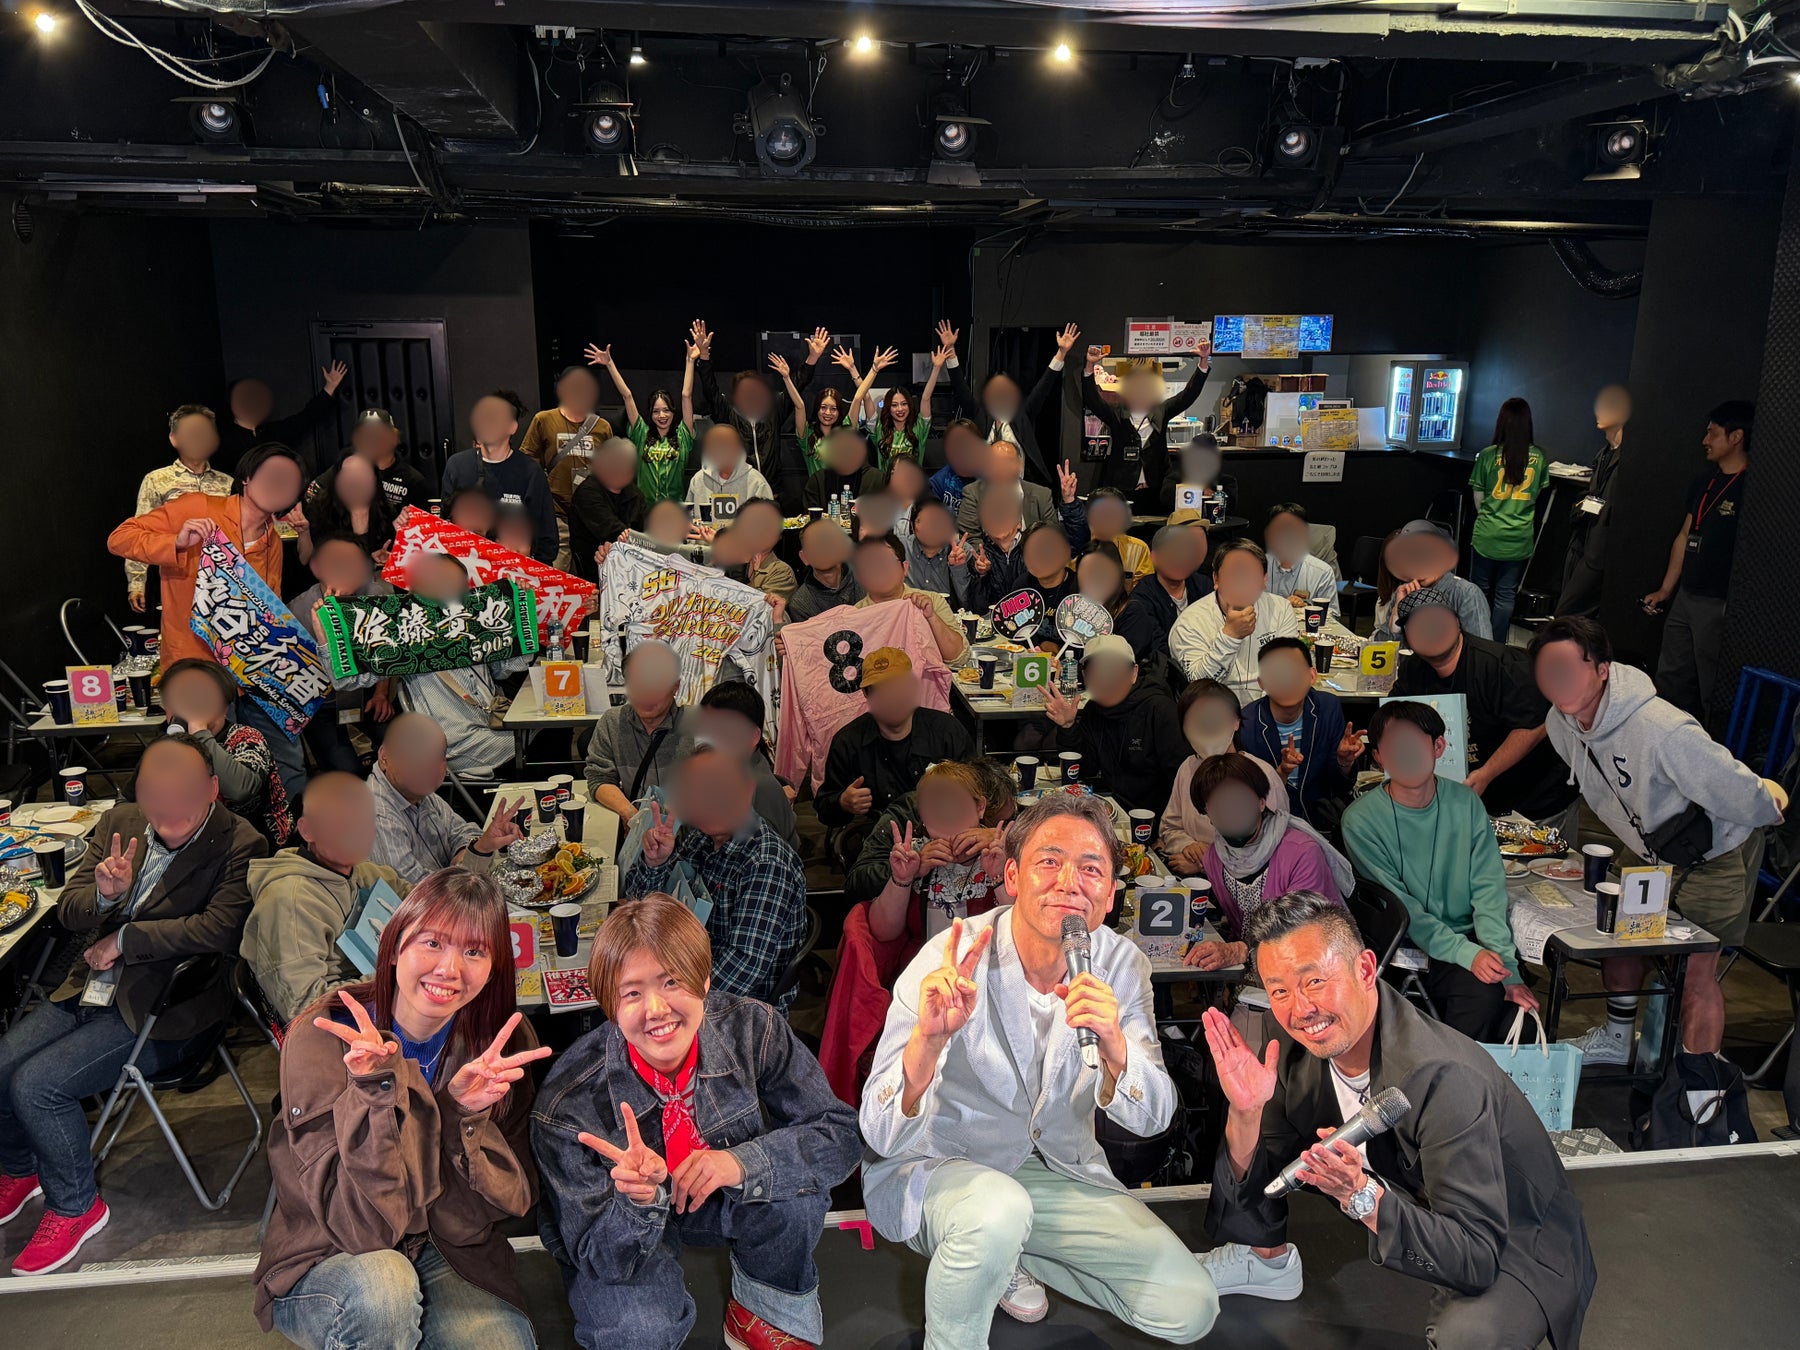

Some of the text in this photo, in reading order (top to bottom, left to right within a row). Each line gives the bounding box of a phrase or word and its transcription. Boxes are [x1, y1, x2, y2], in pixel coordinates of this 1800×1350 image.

[716, 501, 736, 514] 10
[1183, 490, 1195, 505] 9
[202, 544, 227, 563] 38
[219, 561, 268, 613] Kawaguchi
[641, 569, 681, 601] SG
[678, 592, 749, 626] Japan
[1000, 591, 1031, 618] 川口
[1014, 608, 1035, 627] 推し
[329, 613, 343, 638] LOVE
[352, 596, 515, 648] 佐藤貴也
[521, 603, 535, 641] AUTORACE
[1072, 618, 1096, 638] 推し
[335, 636, 352, 674] TAKAYA
[471, 631, 514, 662] 5905
[526, 639, 536, 651] NO
[243, 635, 331, 706] 和香
[823, 630, 866, 694] 8
[1024, 662, 1041, 682] 6
[1371, 651, 1387, 669] 5
[81, 675, 102, 697] 8
[247, 672, 280, 701] Nodoka
[553, 670, 572, 691] 7
[1612, 754, 1632, 788] S
[1638, 879, 1650, 905] 1
[1150, 900, 1173, 928] 2
